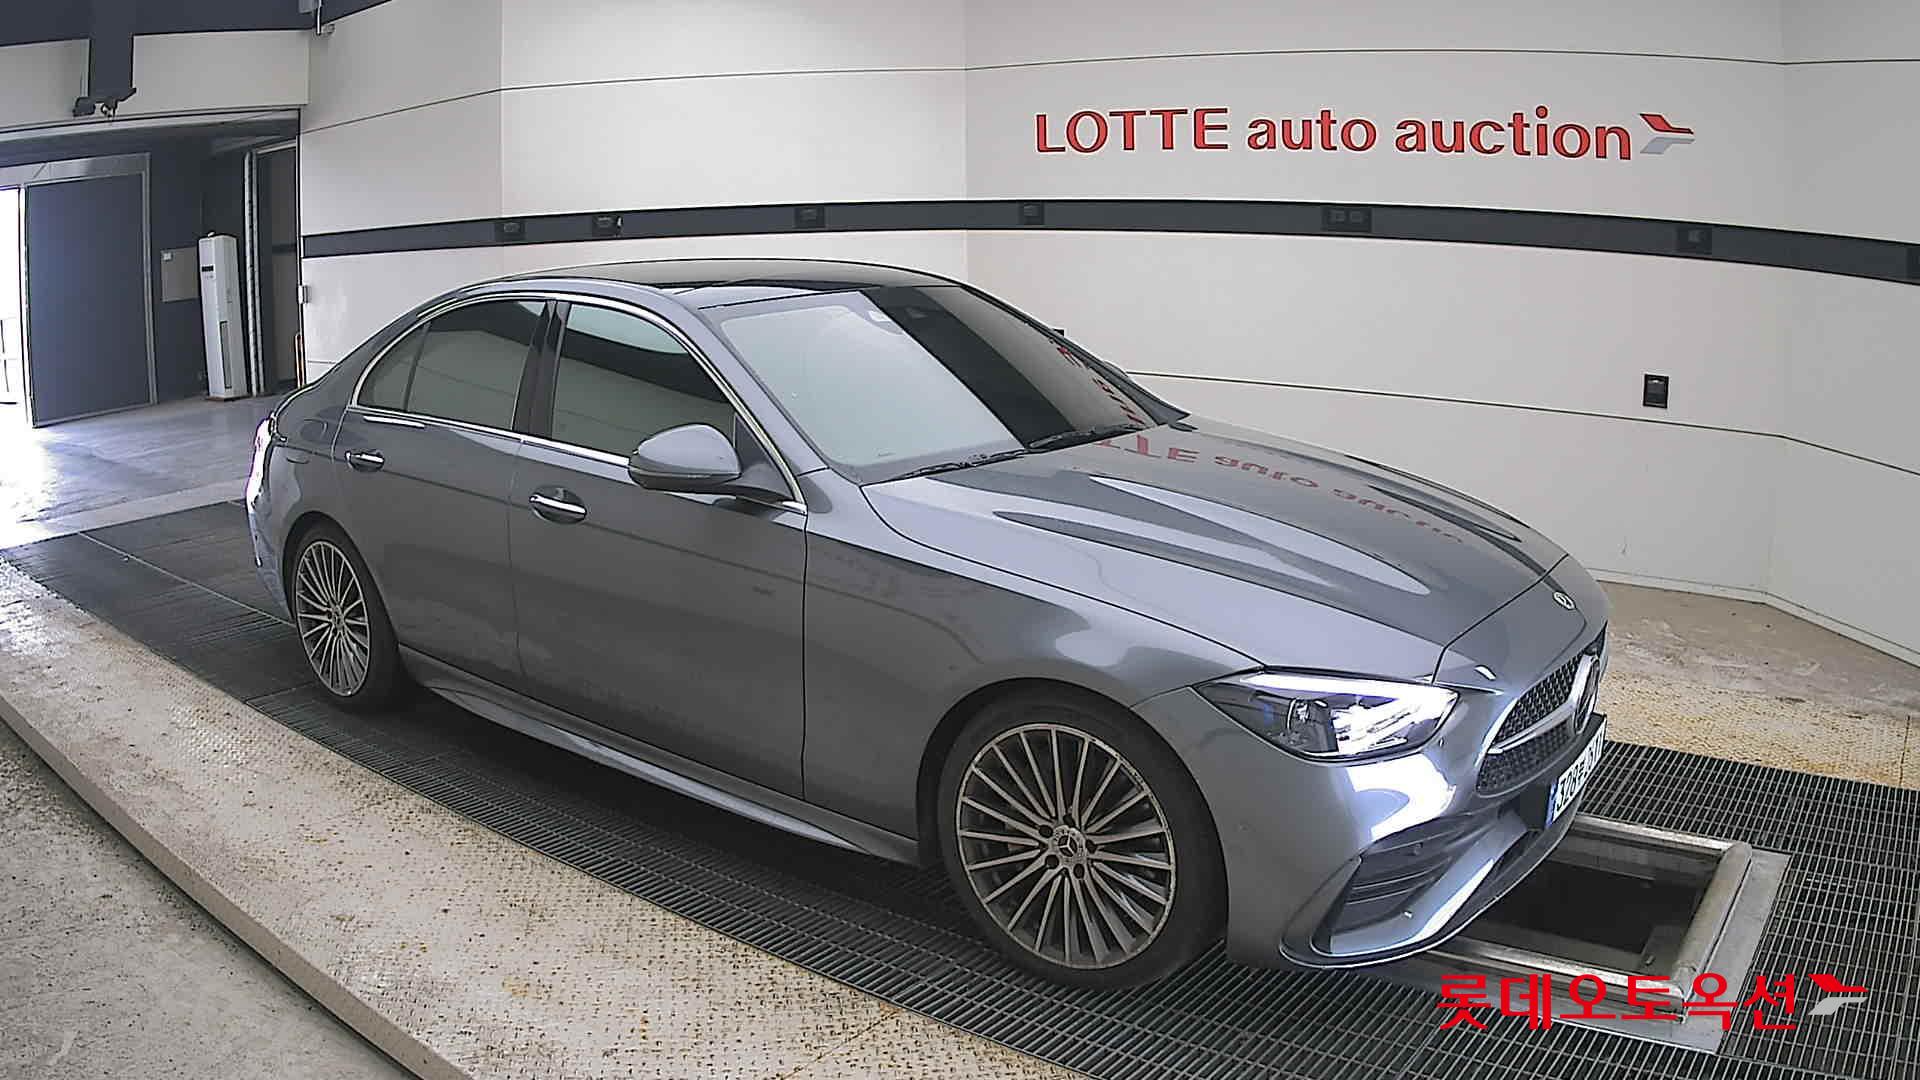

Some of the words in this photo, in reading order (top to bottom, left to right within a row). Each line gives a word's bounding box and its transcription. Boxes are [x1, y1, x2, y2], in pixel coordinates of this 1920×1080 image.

[1035, 107, 1228, 154] LOTTE
[1247, 109, 1378, 152] auto
[1394, 106, 1634, 161] auction
